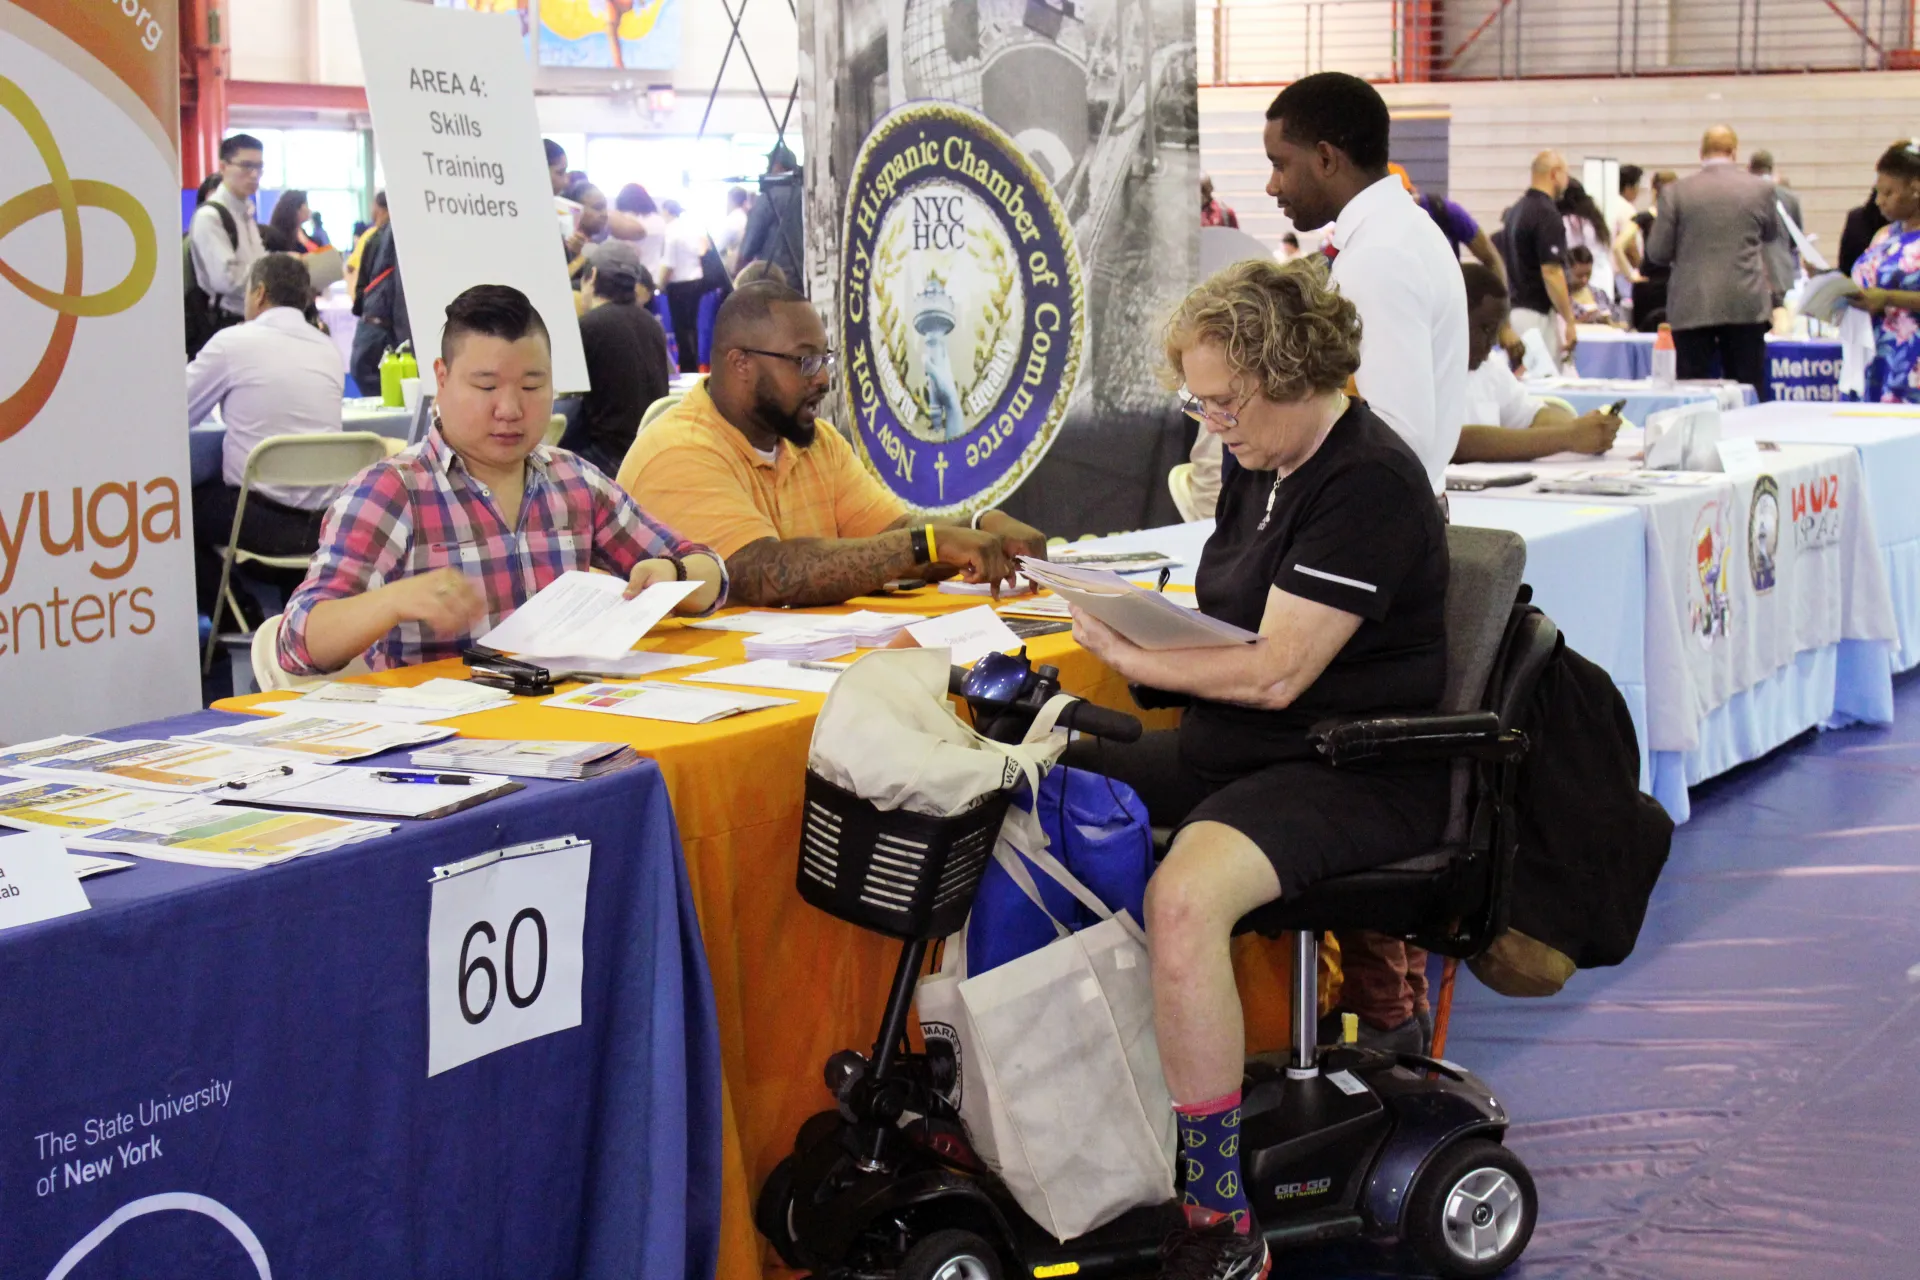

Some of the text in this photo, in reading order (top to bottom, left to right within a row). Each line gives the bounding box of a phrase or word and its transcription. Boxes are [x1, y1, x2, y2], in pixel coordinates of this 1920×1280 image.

[410, 67, 488, 97] AREA 4:
[429, 111, 482, 138] Skills
[422, 151, 505, 186] Training
[424, 189, 519, 218] Providers
[912, 195, 965, 223] NYC
[912, 222, 966, 251] HCC
[849, 131, 1061, 484] New York City Hispanic Chamber of Commerce
[0, 585, 156, 657] nters
[0, 883, 20, 900] ab
[458, 906, 549, 1026] 60
[34, 1078, 233, 1160] The State University
[36, 1134, 164, 1197] of New York
